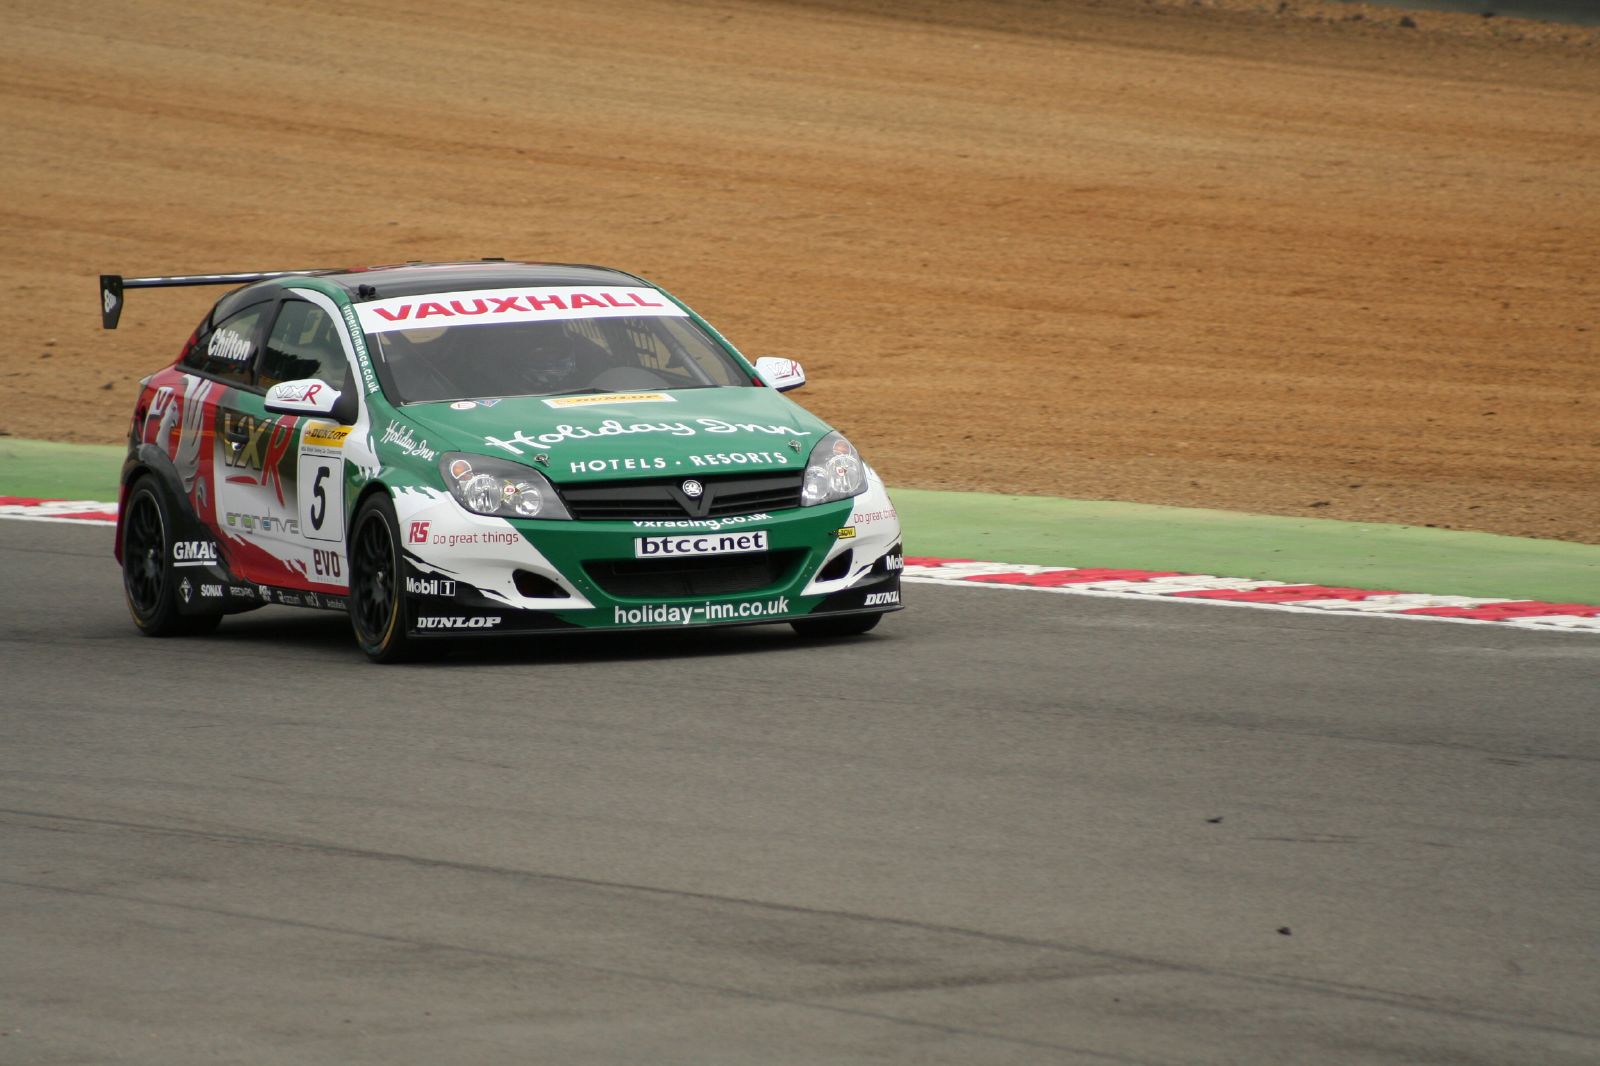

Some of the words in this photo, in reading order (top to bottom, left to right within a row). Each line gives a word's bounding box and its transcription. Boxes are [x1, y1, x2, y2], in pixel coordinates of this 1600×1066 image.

[373, 293, 664, 321] VAUXHALL
[208, 327, 251, 360] Chilton
[380, 419, 417, 455] Holiday
[411, 439, 435, 461] Inn
[485, 418, 696, 454] Holiday
[696, 418, 811, 436] Inn
[571, 457, 666, 474] HOTELS
[689, 451, 788, 467] RESORTS
[311, 466, 330, 531] 5
[633, 513, 773, 530] vxracing.co.uk
[854, 514, 864, 523] Do
[865, 511, 882, 524] great
[409, 522, 430, 543] RS
[433, 535, 446, 544] Do
[449, 534, 478, 546] great
[482, 531, 519, 545] things
[641, 532, 764, 555] btcc.net
[173, 541, 217, 560] GMAC
[313, 549, 341, 577] evo
[200, 584, 223, 597] SONAX
[406, 577, 437, 594] Mobil
[614, 596, 789, 624] holiday-inn.co.uk
[417, 617, 501, 628] DUNLOP
